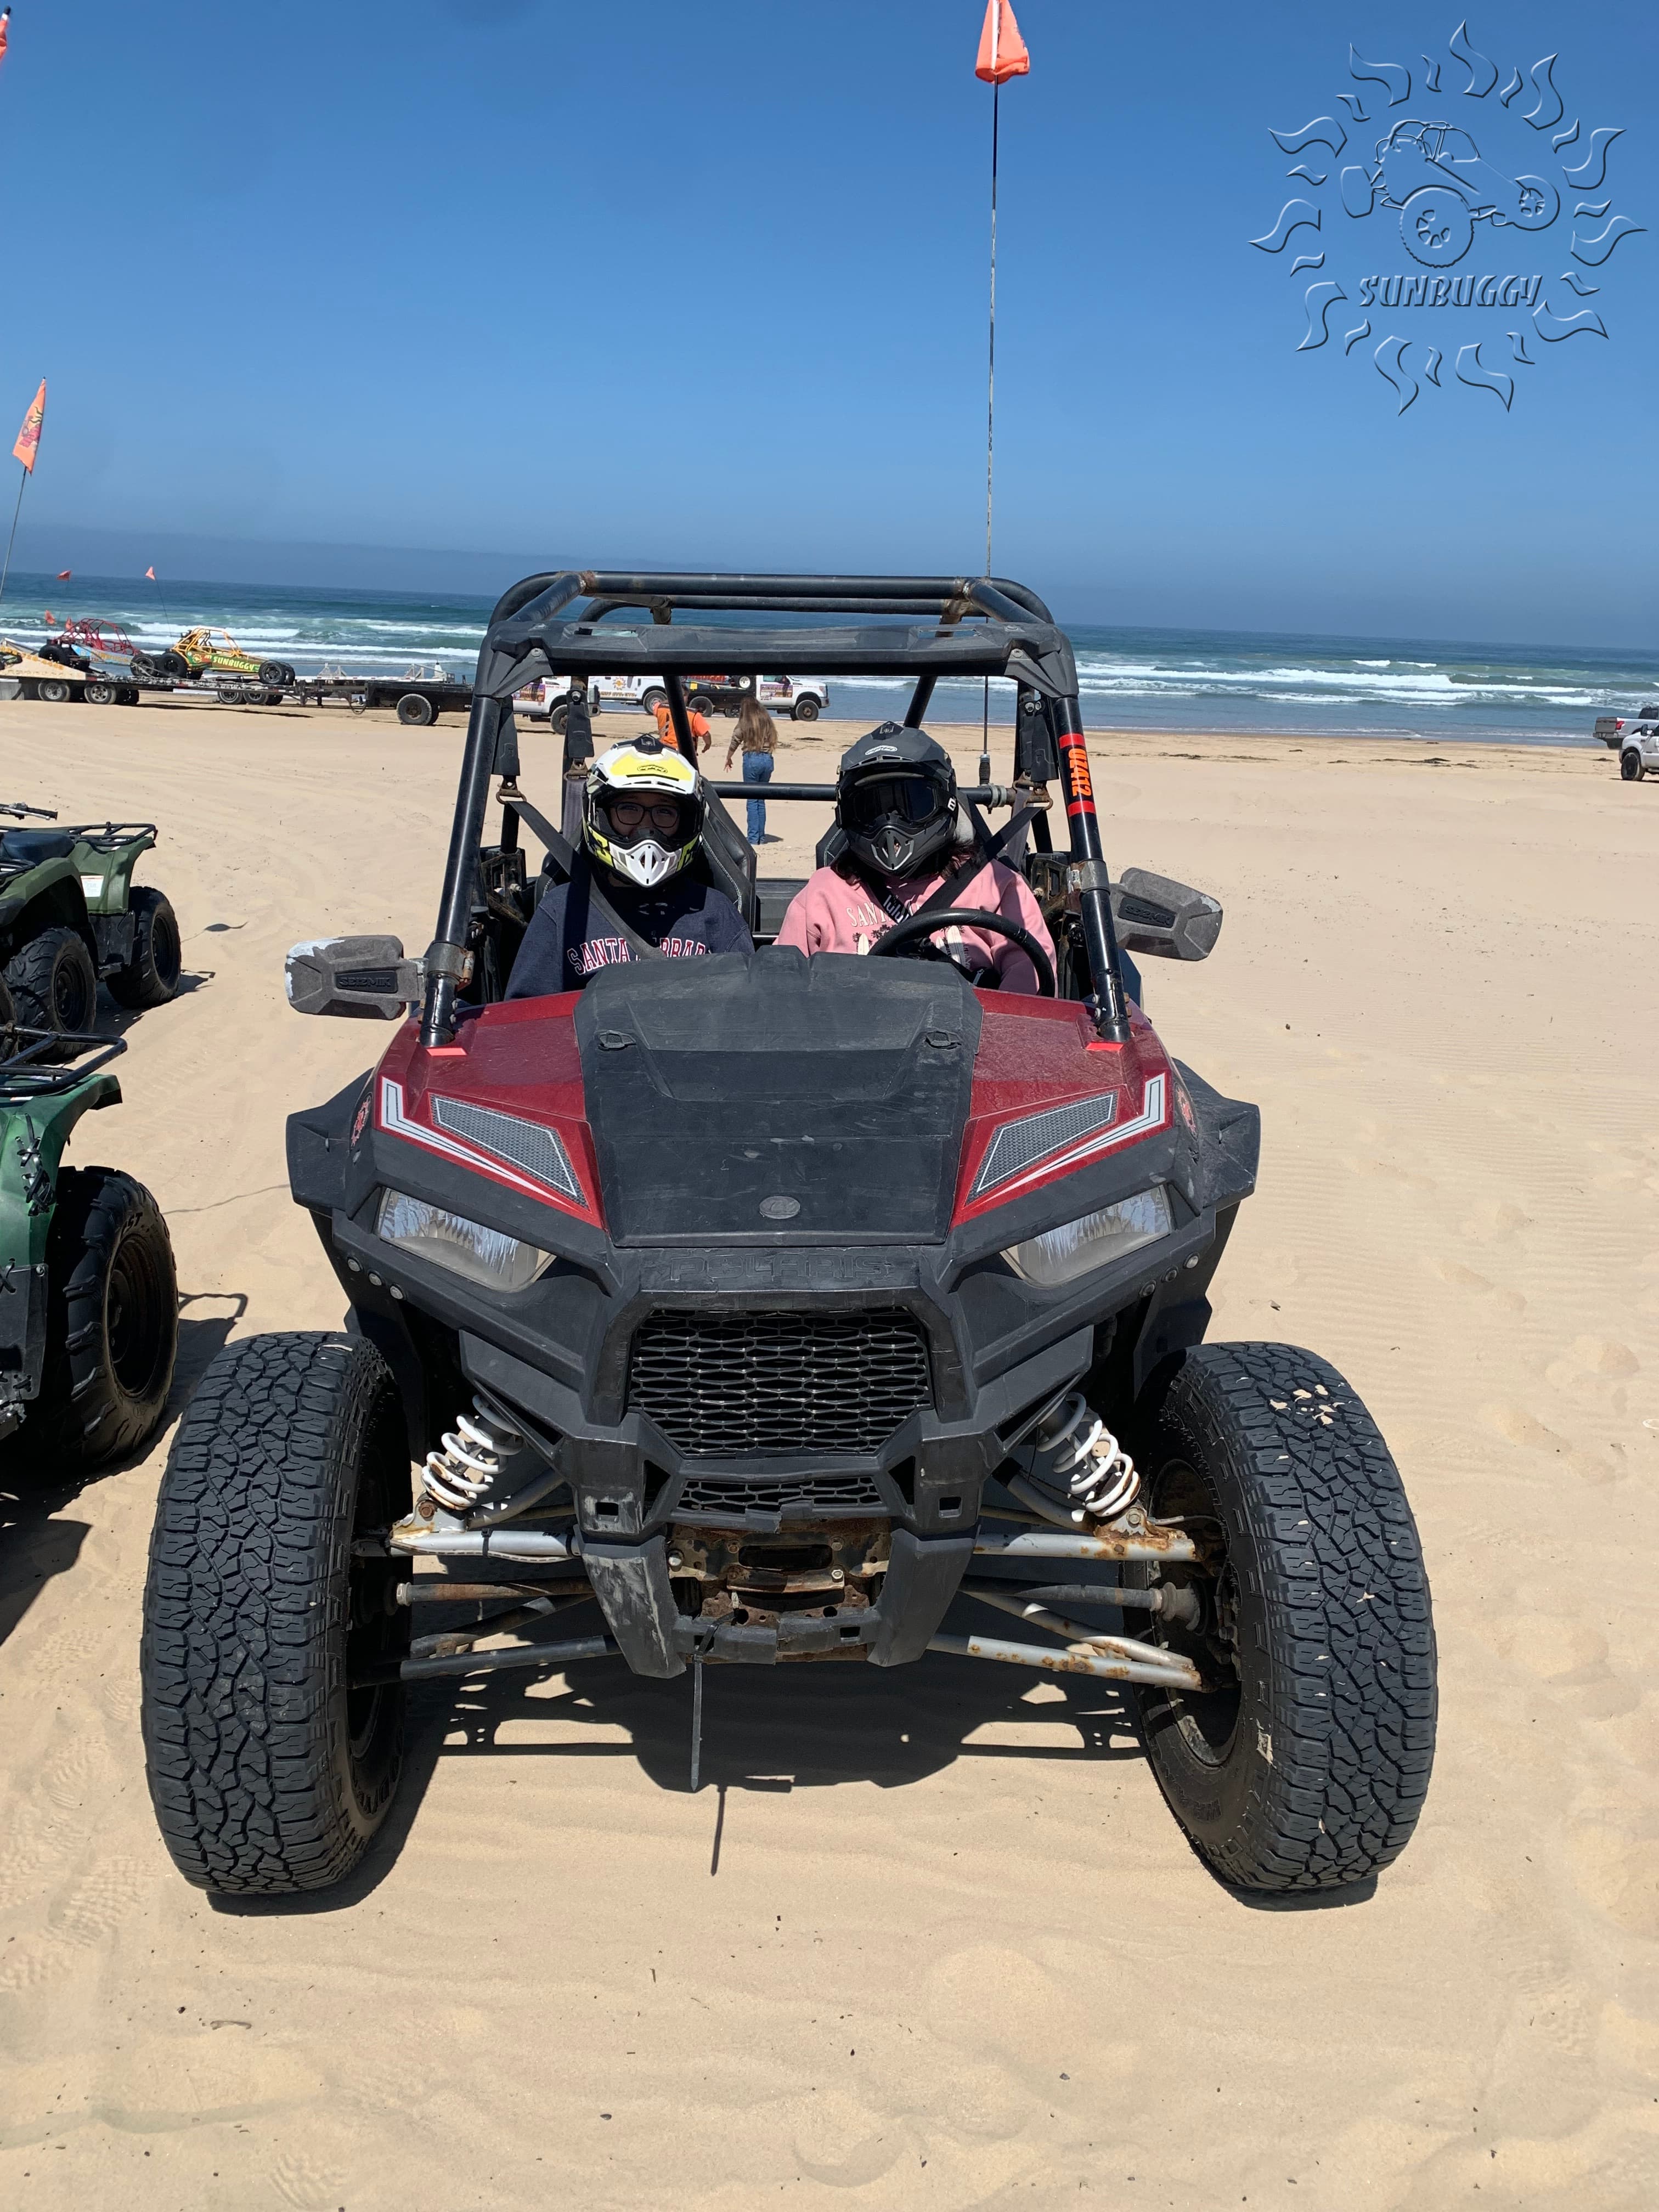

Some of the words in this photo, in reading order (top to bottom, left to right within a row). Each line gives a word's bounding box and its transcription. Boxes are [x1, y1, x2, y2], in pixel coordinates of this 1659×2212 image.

[213, 656, 255, 671] SUNBUGGY
[1068, 748, 1092, 797] UZ412
[846, 902, 892, 927] SANT
[883, 895, 909, 924] lulu
[567, 938, 630, 975] SANTA
[635, 938, 712, 961] RBAR
[669, 1252, 892, 1282] POLARIS
